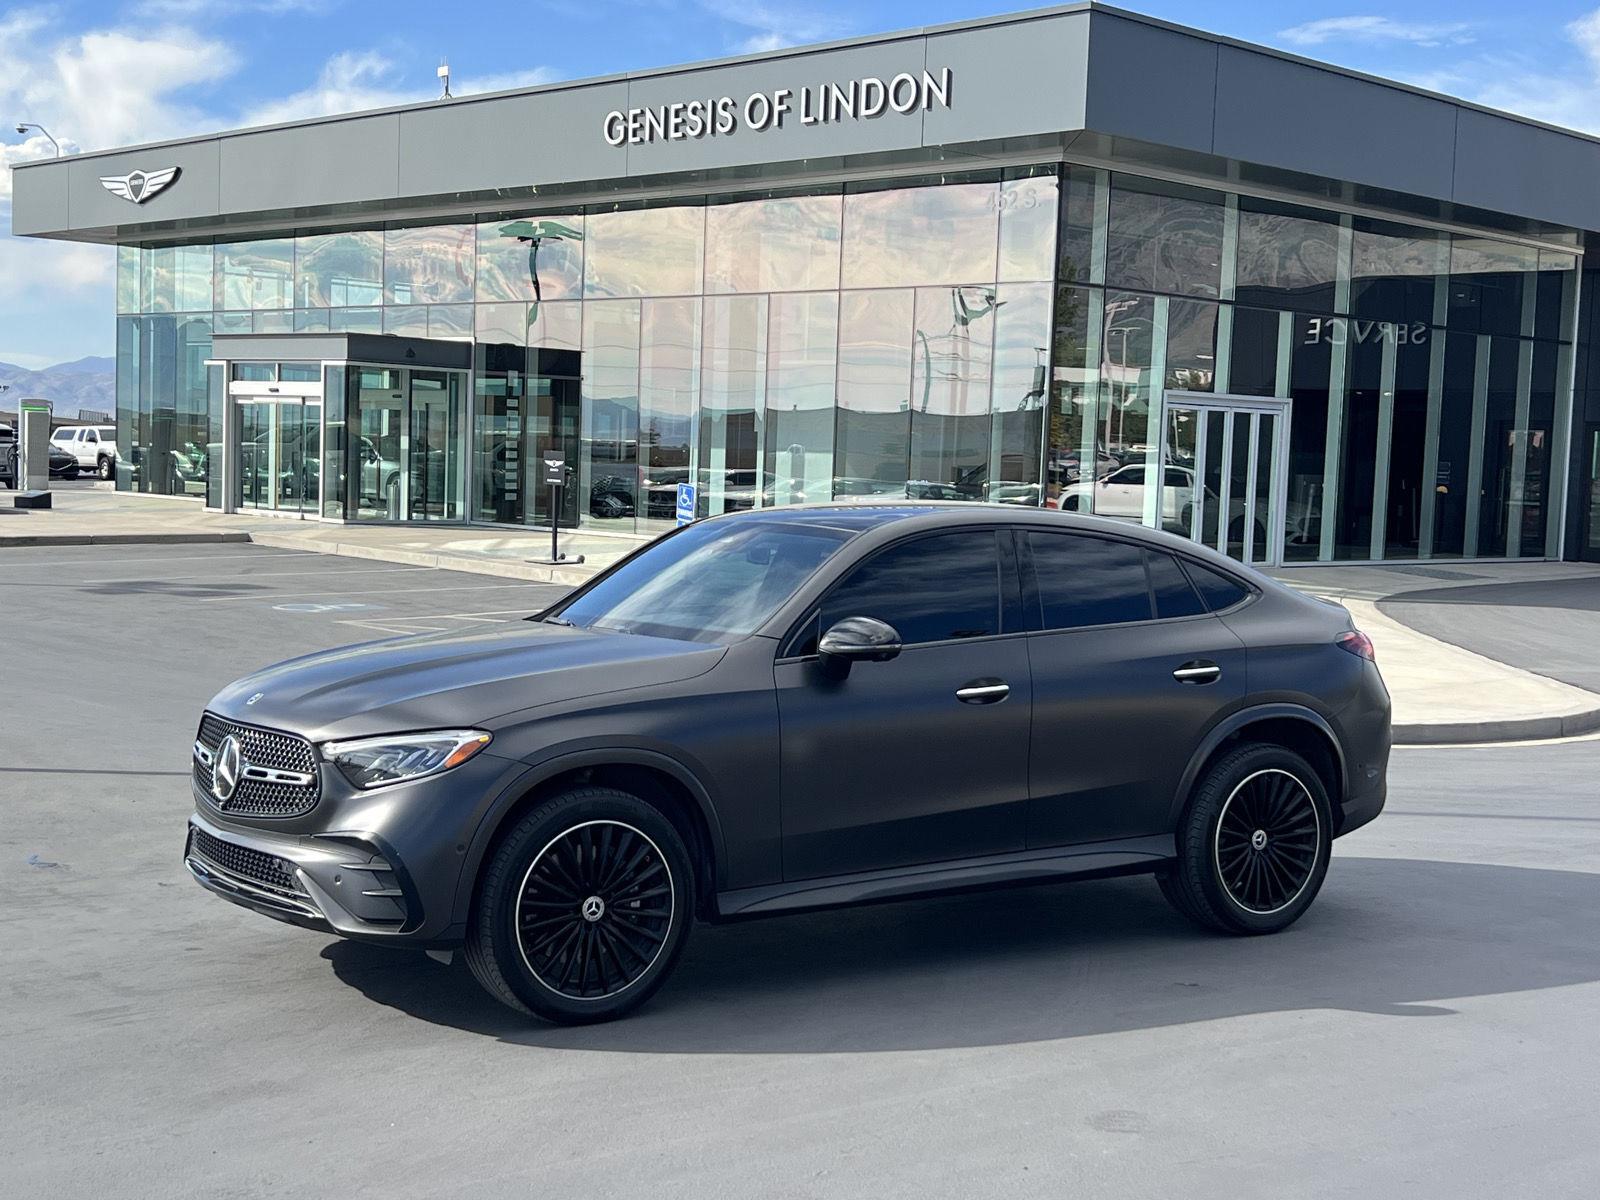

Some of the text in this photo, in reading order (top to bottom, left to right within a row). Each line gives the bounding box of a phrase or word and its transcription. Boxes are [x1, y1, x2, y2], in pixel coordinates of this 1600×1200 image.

[603, 67, 952, 147] GENESIS OF LINDON
